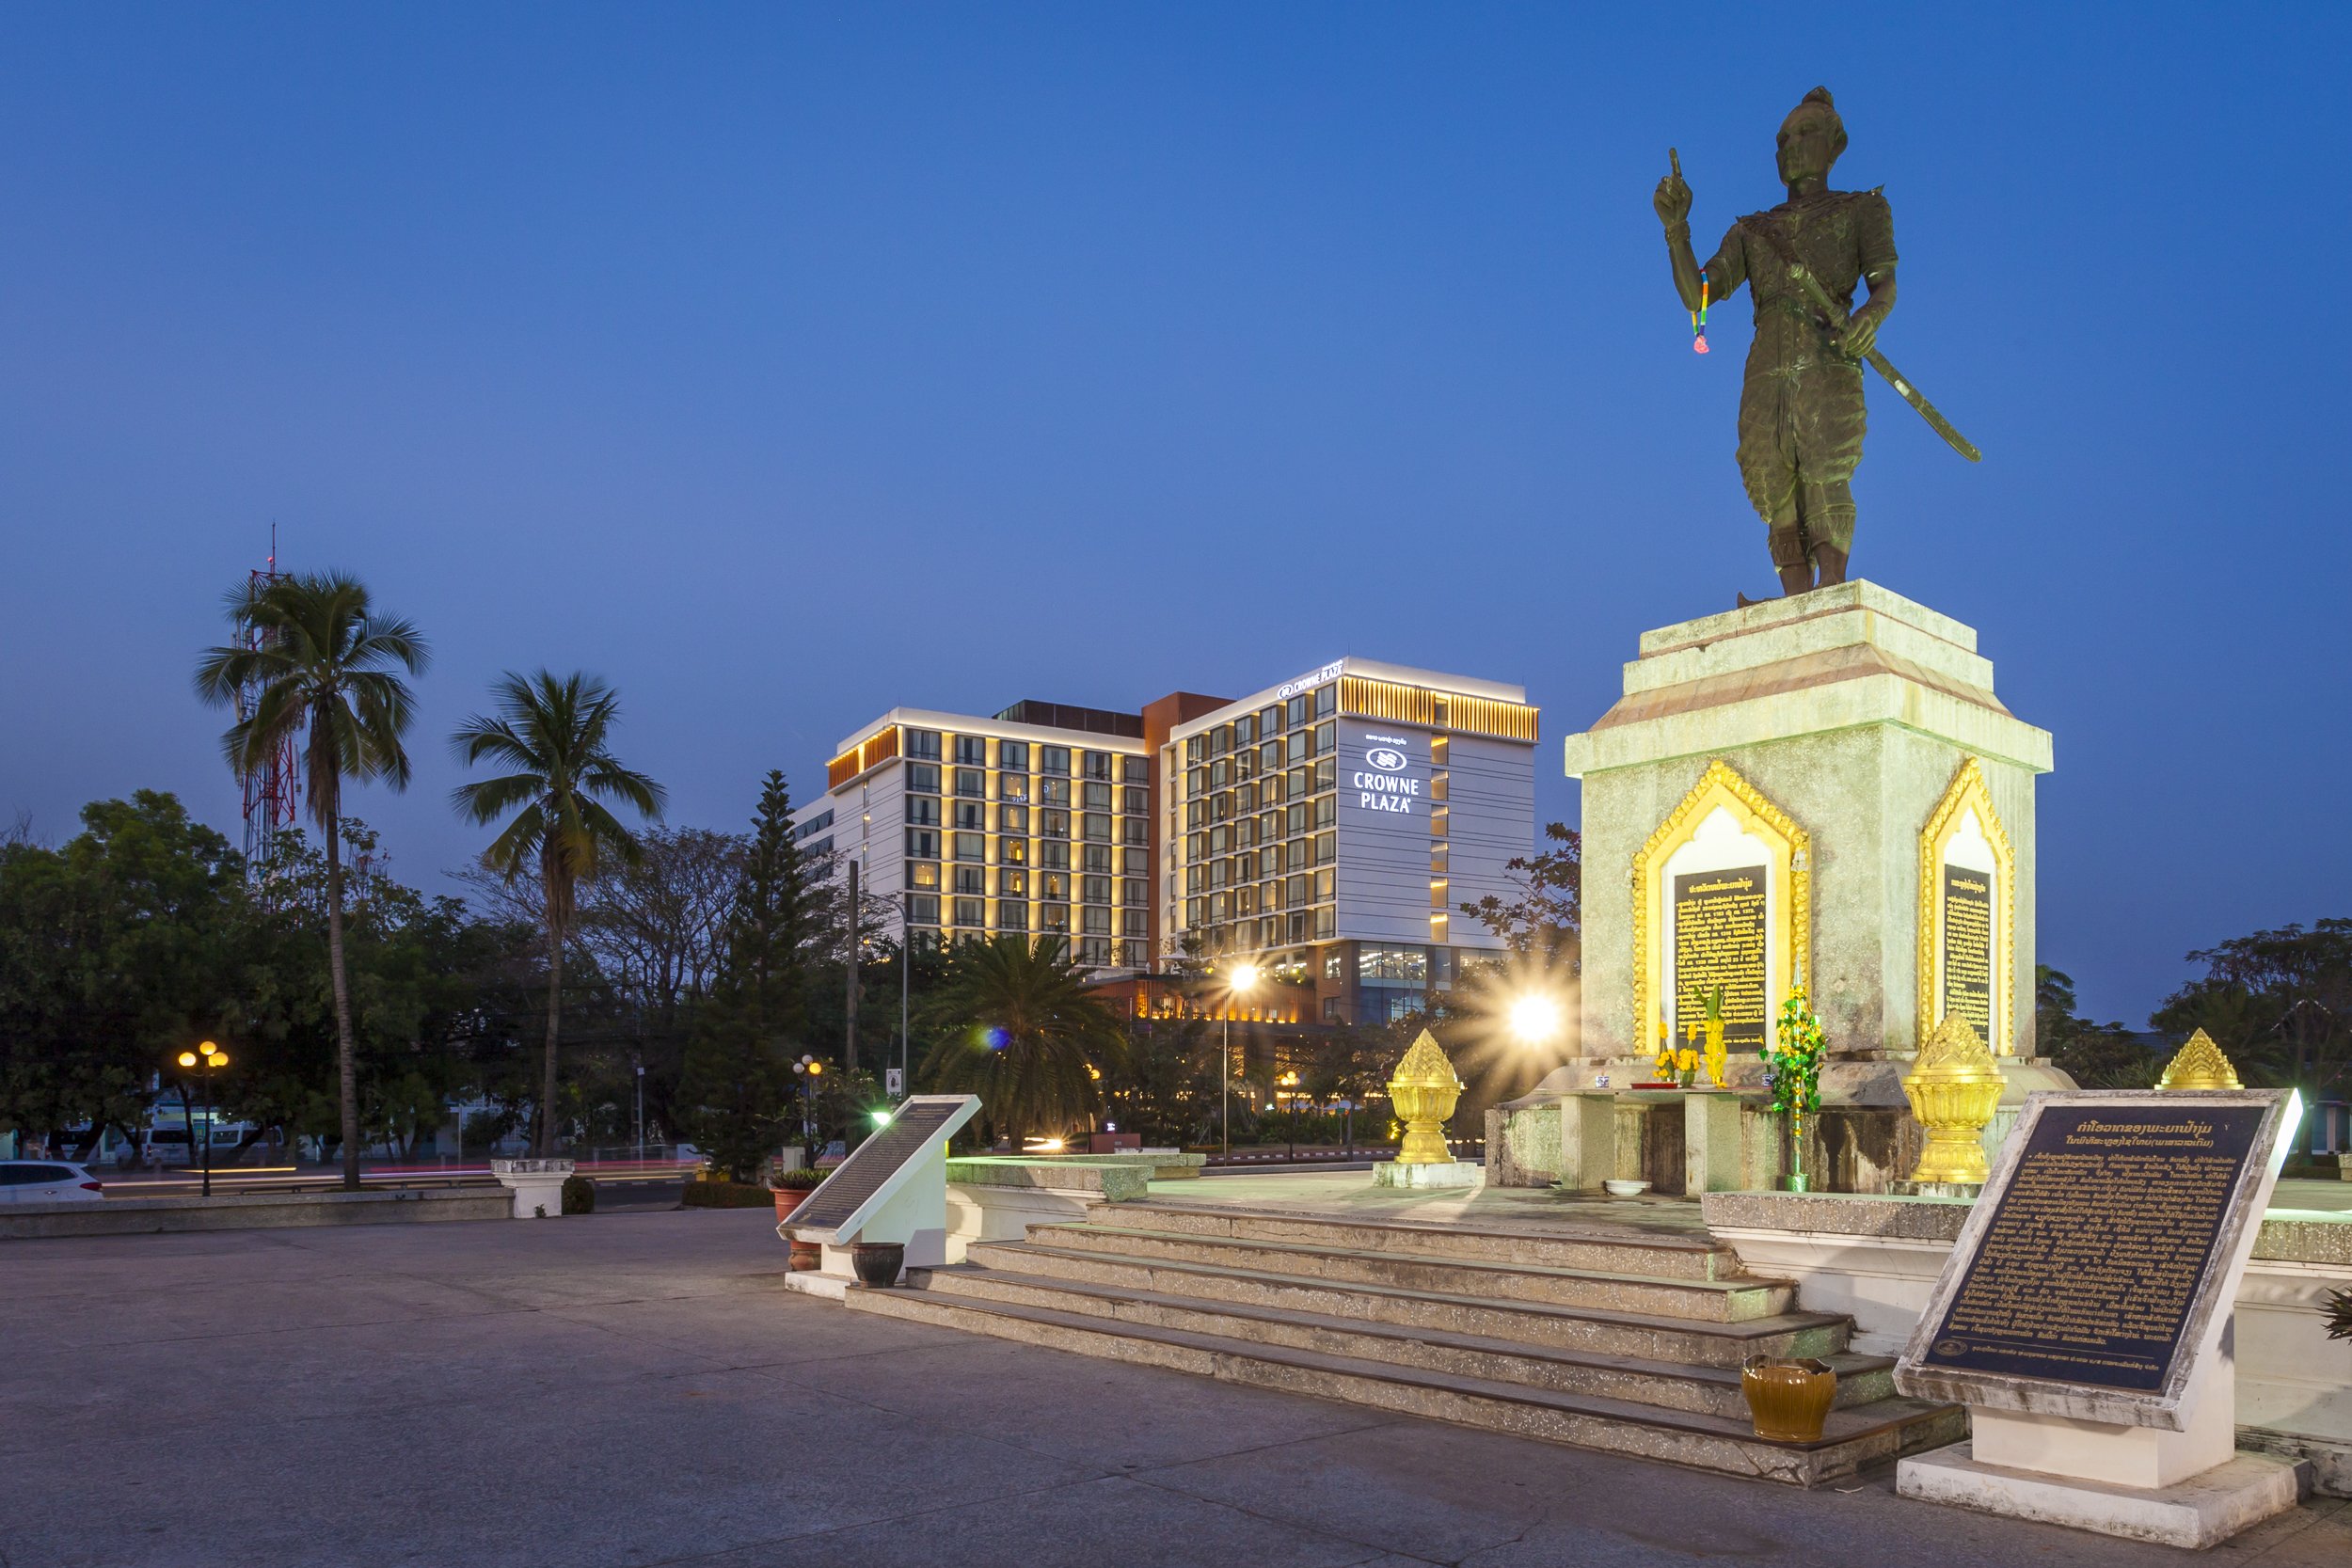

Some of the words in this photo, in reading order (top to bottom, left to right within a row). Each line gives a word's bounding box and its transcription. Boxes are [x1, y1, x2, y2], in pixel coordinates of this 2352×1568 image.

[1294, 673, 1321, 692] CROWNE
[1322, 664, 1343, 683] PLAZA
[1354, 771, 1419, 796] CROWNE
[1360, 791, 1411, 815] PLAZA
